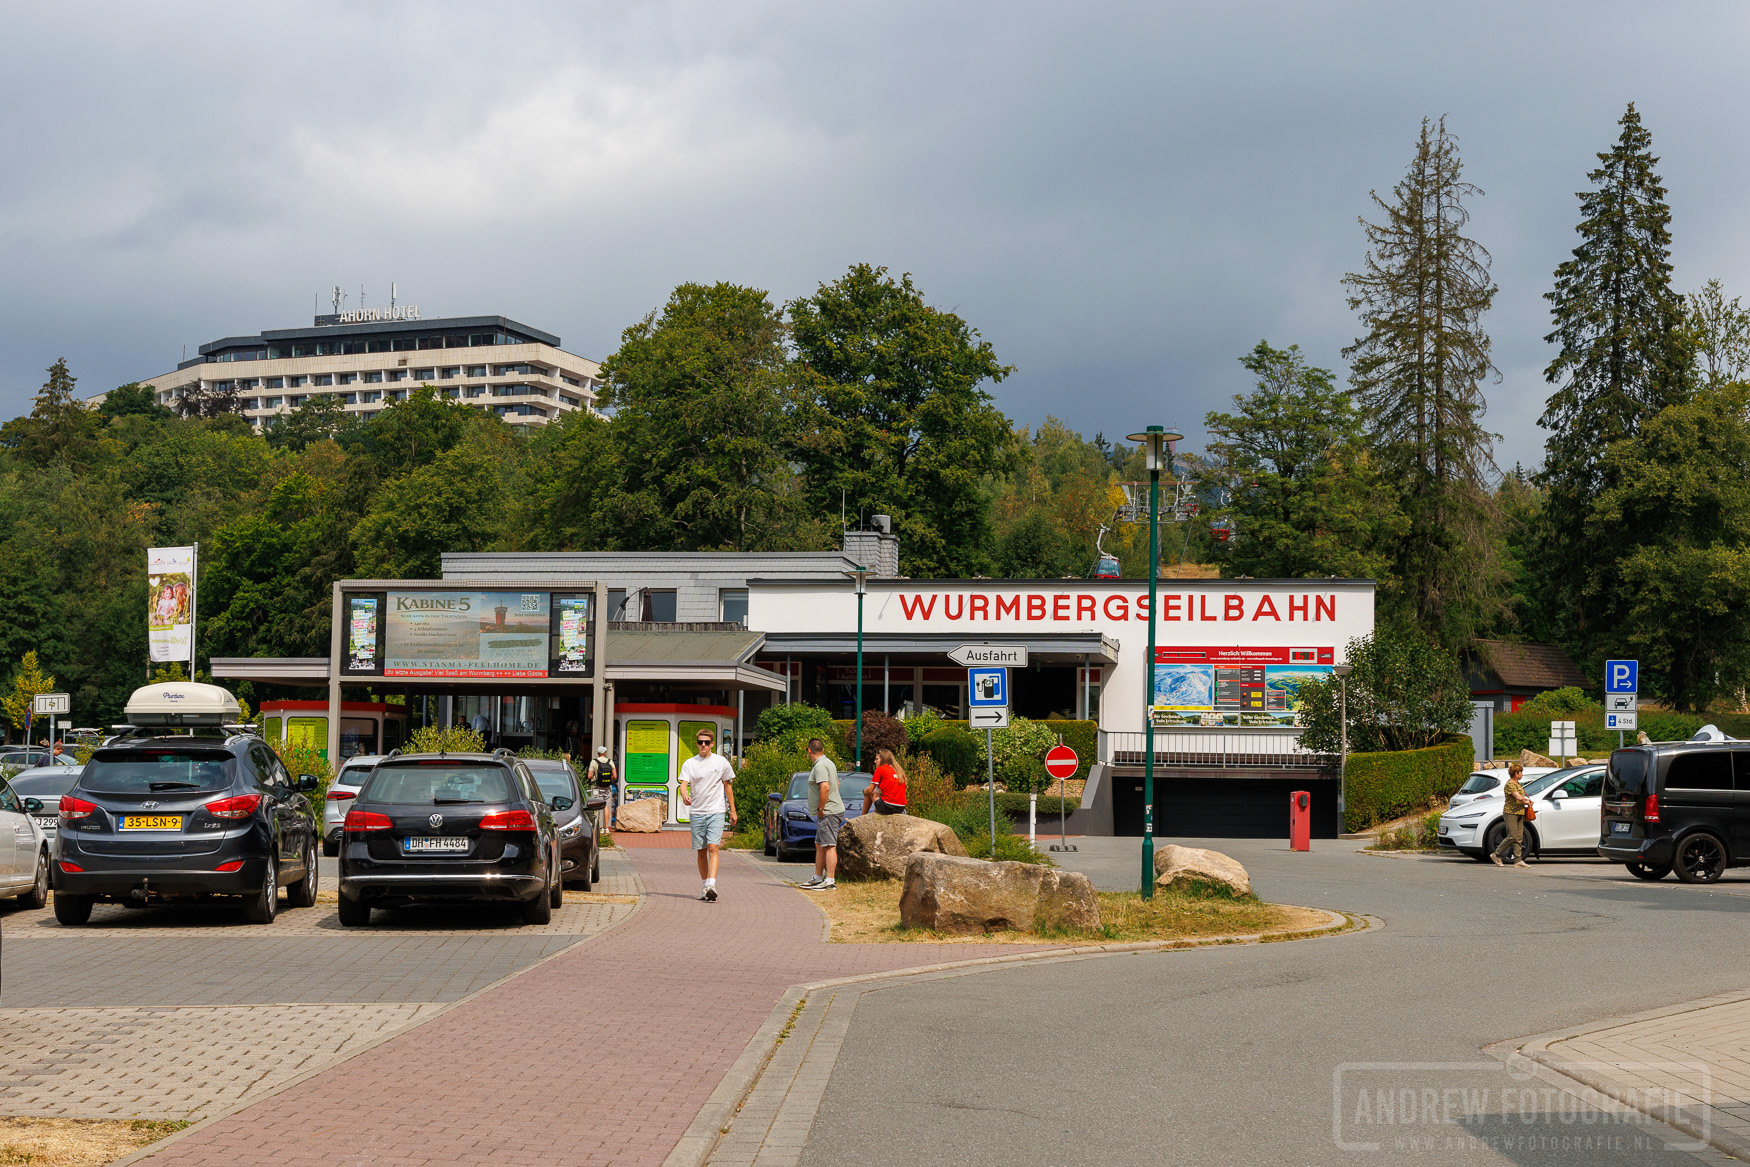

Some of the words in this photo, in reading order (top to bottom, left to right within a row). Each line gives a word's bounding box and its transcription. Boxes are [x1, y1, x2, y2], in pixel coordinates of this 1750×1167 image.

[340, 307, 380, 322] AHORN
[384, 305, 421, 320] HOTEL
[396, 596, 456, 610] KABINE
[458, 597, 471, 611] 5
[899, 595, 1336, 621] WURMBERGSEILBAHN
[966, 650, 1018, 661] Ausfahrt
[1614, 665, 1630, 688] P
[128, 818, 178, 827] 35-LSN-9
[412, 838, 423, 848] DH
[430, 838, 442, 848] FH
[444, 838, 466, 848] 4484
